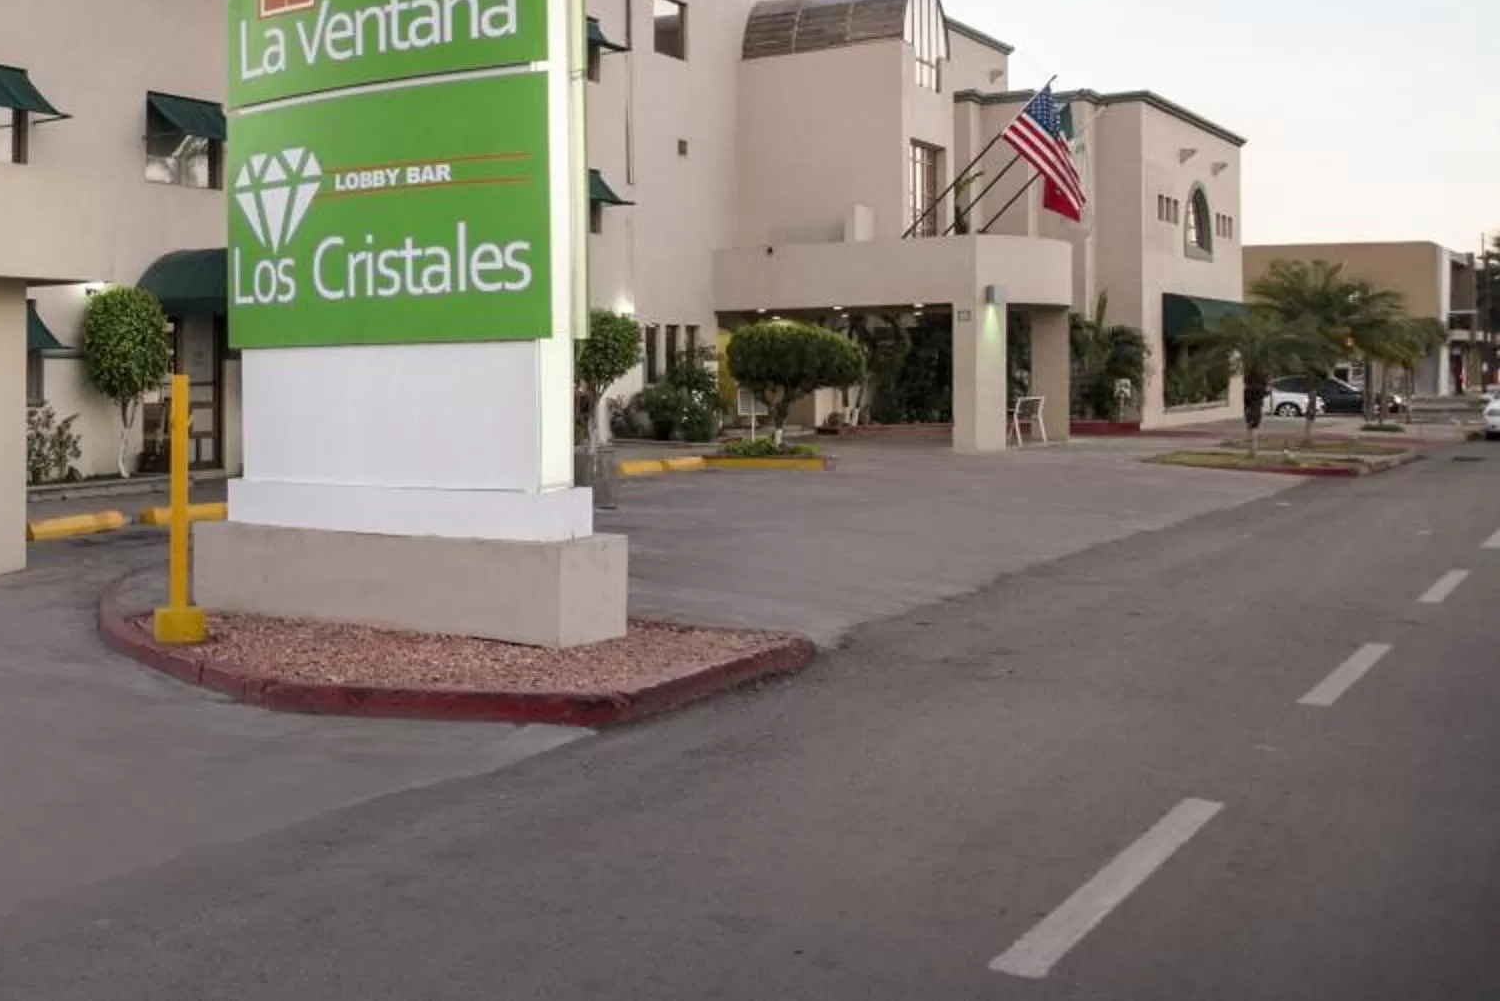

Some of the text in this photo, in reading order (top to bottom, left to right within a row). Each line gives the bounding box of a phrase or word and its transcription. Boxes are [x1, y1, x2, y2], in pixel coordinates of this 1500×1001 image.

[240, 19, 287, 81] La
[334, 163, 451, 191] LOBBY BAR
[234, 221, 533, 305] Los Cristales
